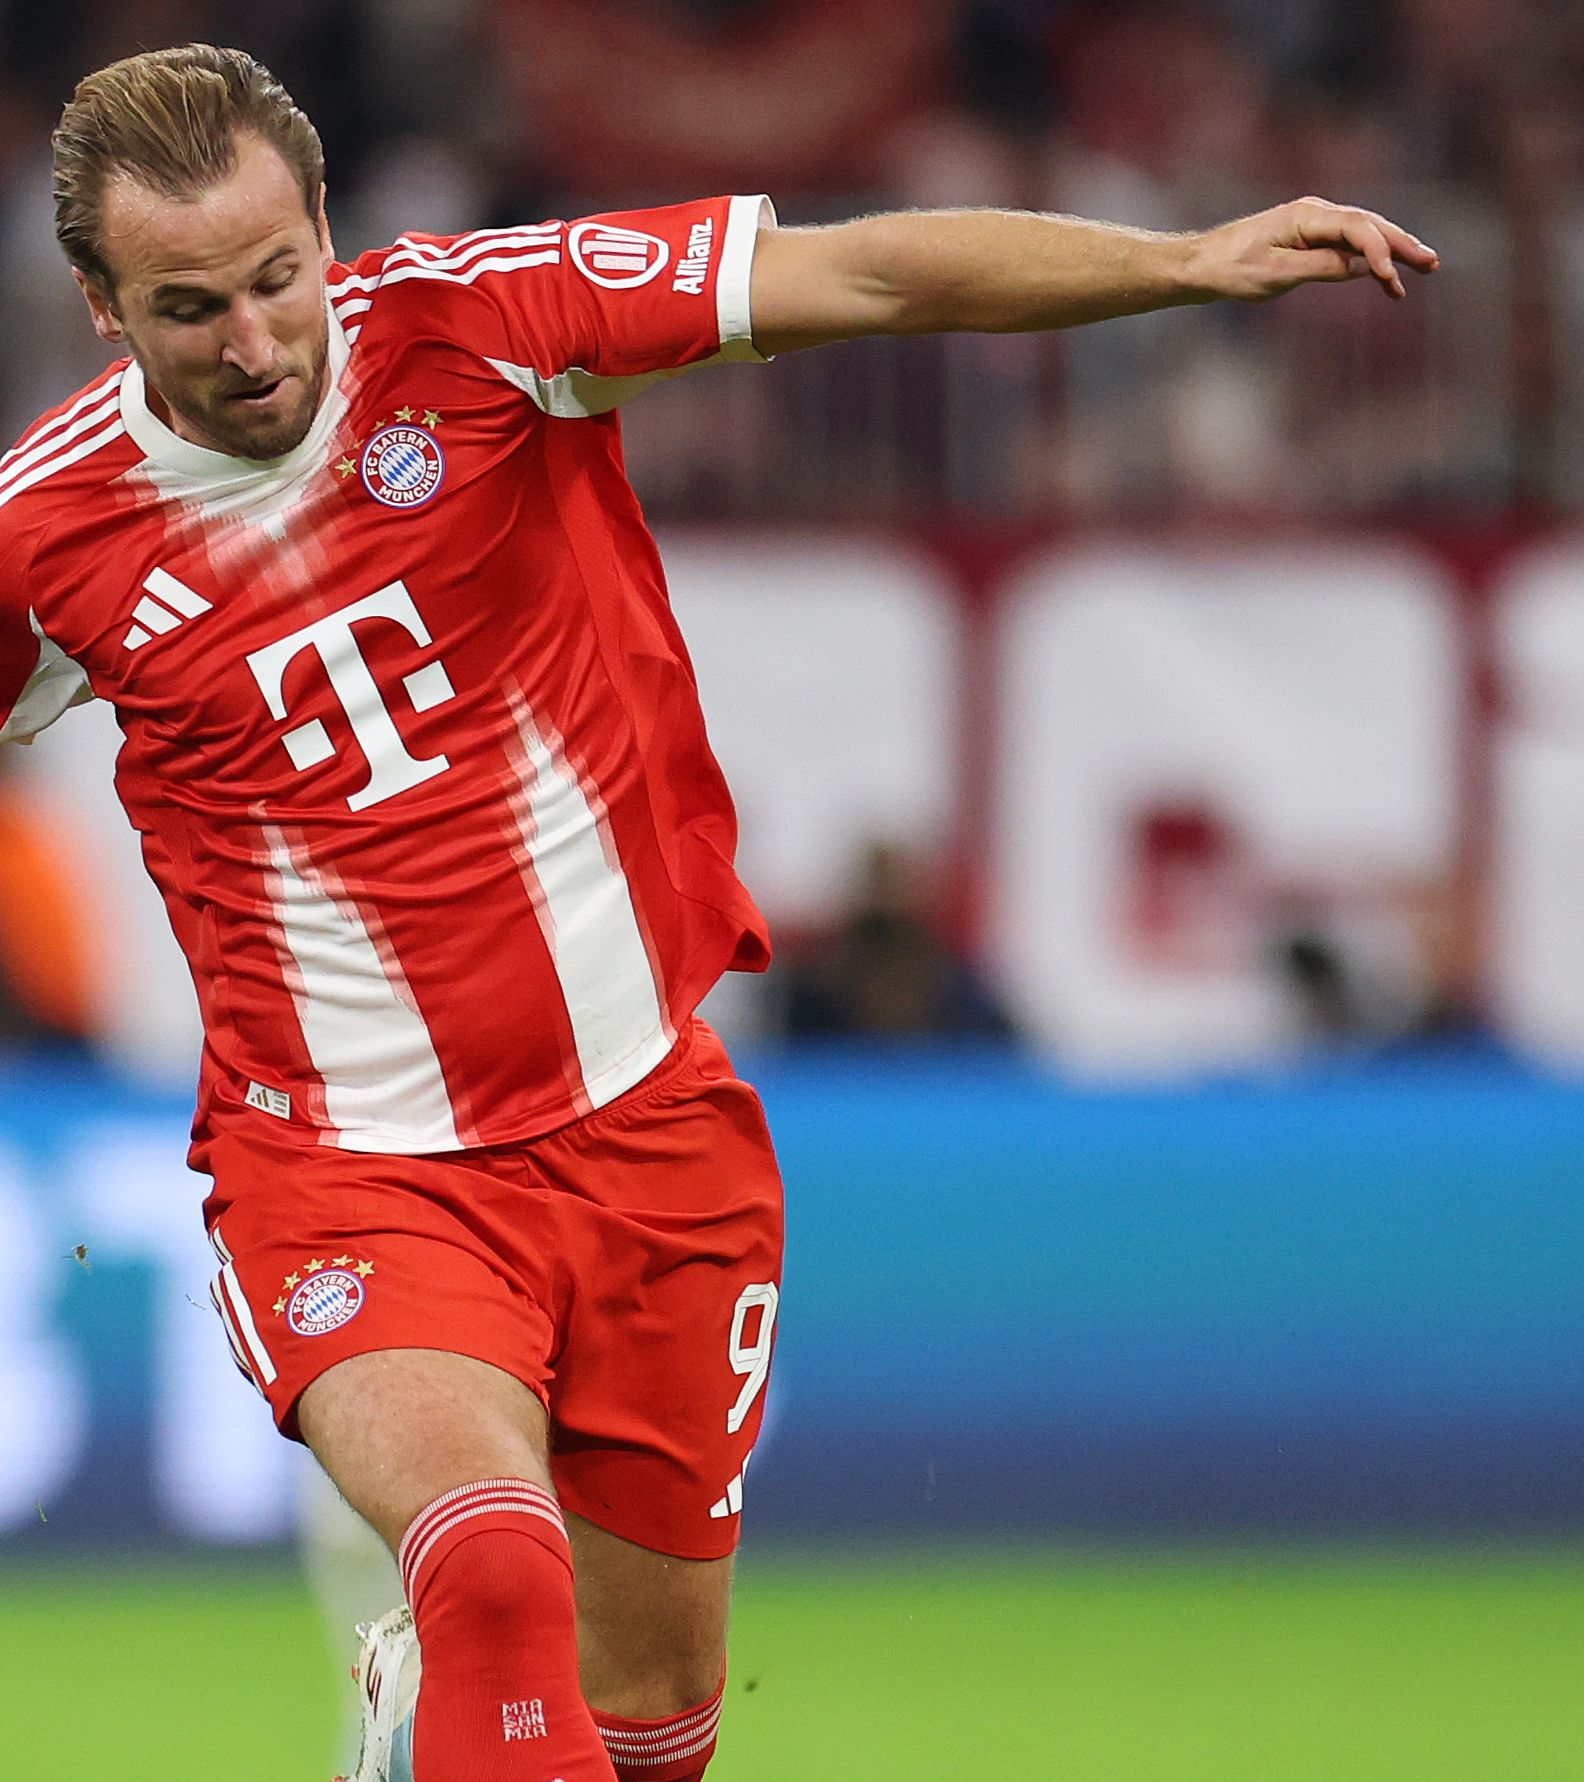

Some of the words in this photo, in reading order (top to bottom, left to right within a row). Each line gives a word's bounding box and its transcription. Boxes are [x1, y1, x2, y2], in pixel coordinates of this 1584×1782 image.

[672, 217, 713, 295] Allianz
[372, 431, 428, 455] BAYERN
[367, 457, 378, 476] FC
[245, 579, 457, 813] T
[303, 1275, 355, 1295] BAYERN
[727, 1281, 779, 1435] 9
[502, 1698, 543, 1717] MIA
[505, 1725, 548, 1742] MIA
